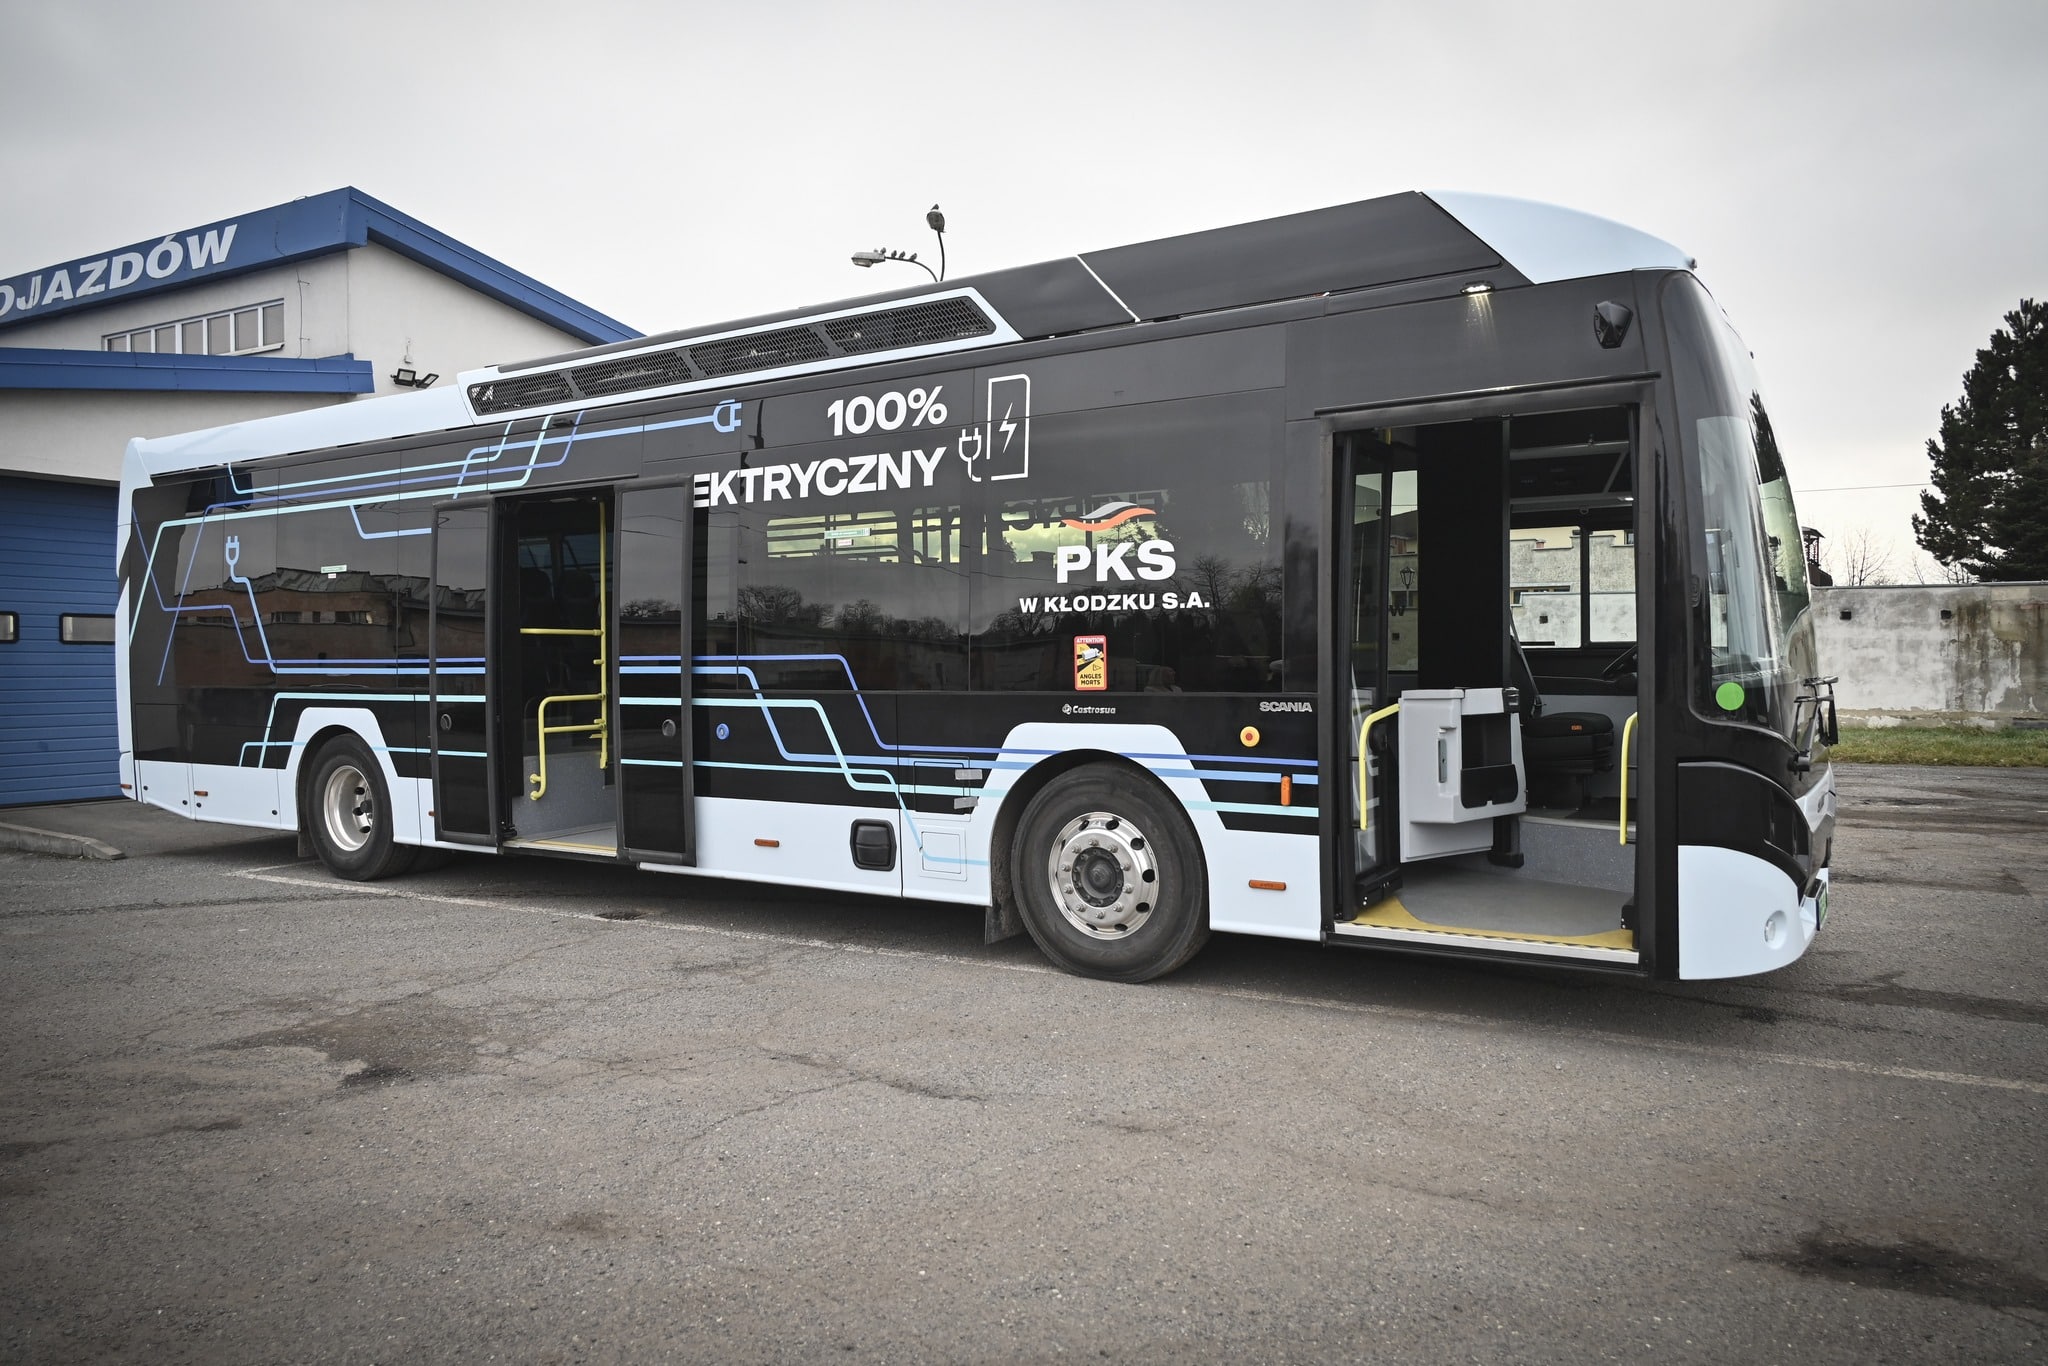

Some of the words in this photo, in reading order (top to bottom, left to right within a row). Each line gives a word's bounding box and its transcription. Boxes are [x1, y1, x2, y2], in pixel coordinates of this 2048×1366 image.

[827, 386, 948, 436] 100%
[1056, 540, 1177, 584] PKS
[1019, 598, 1038, 613] W
[1044, 593, 1155, 613] KŁODZKU
[1162, 592, 1210, 609] S.A.
[1072, 705, 1117, 714] Castrosua
[1259, 701, 1313, 713] SCANIA
